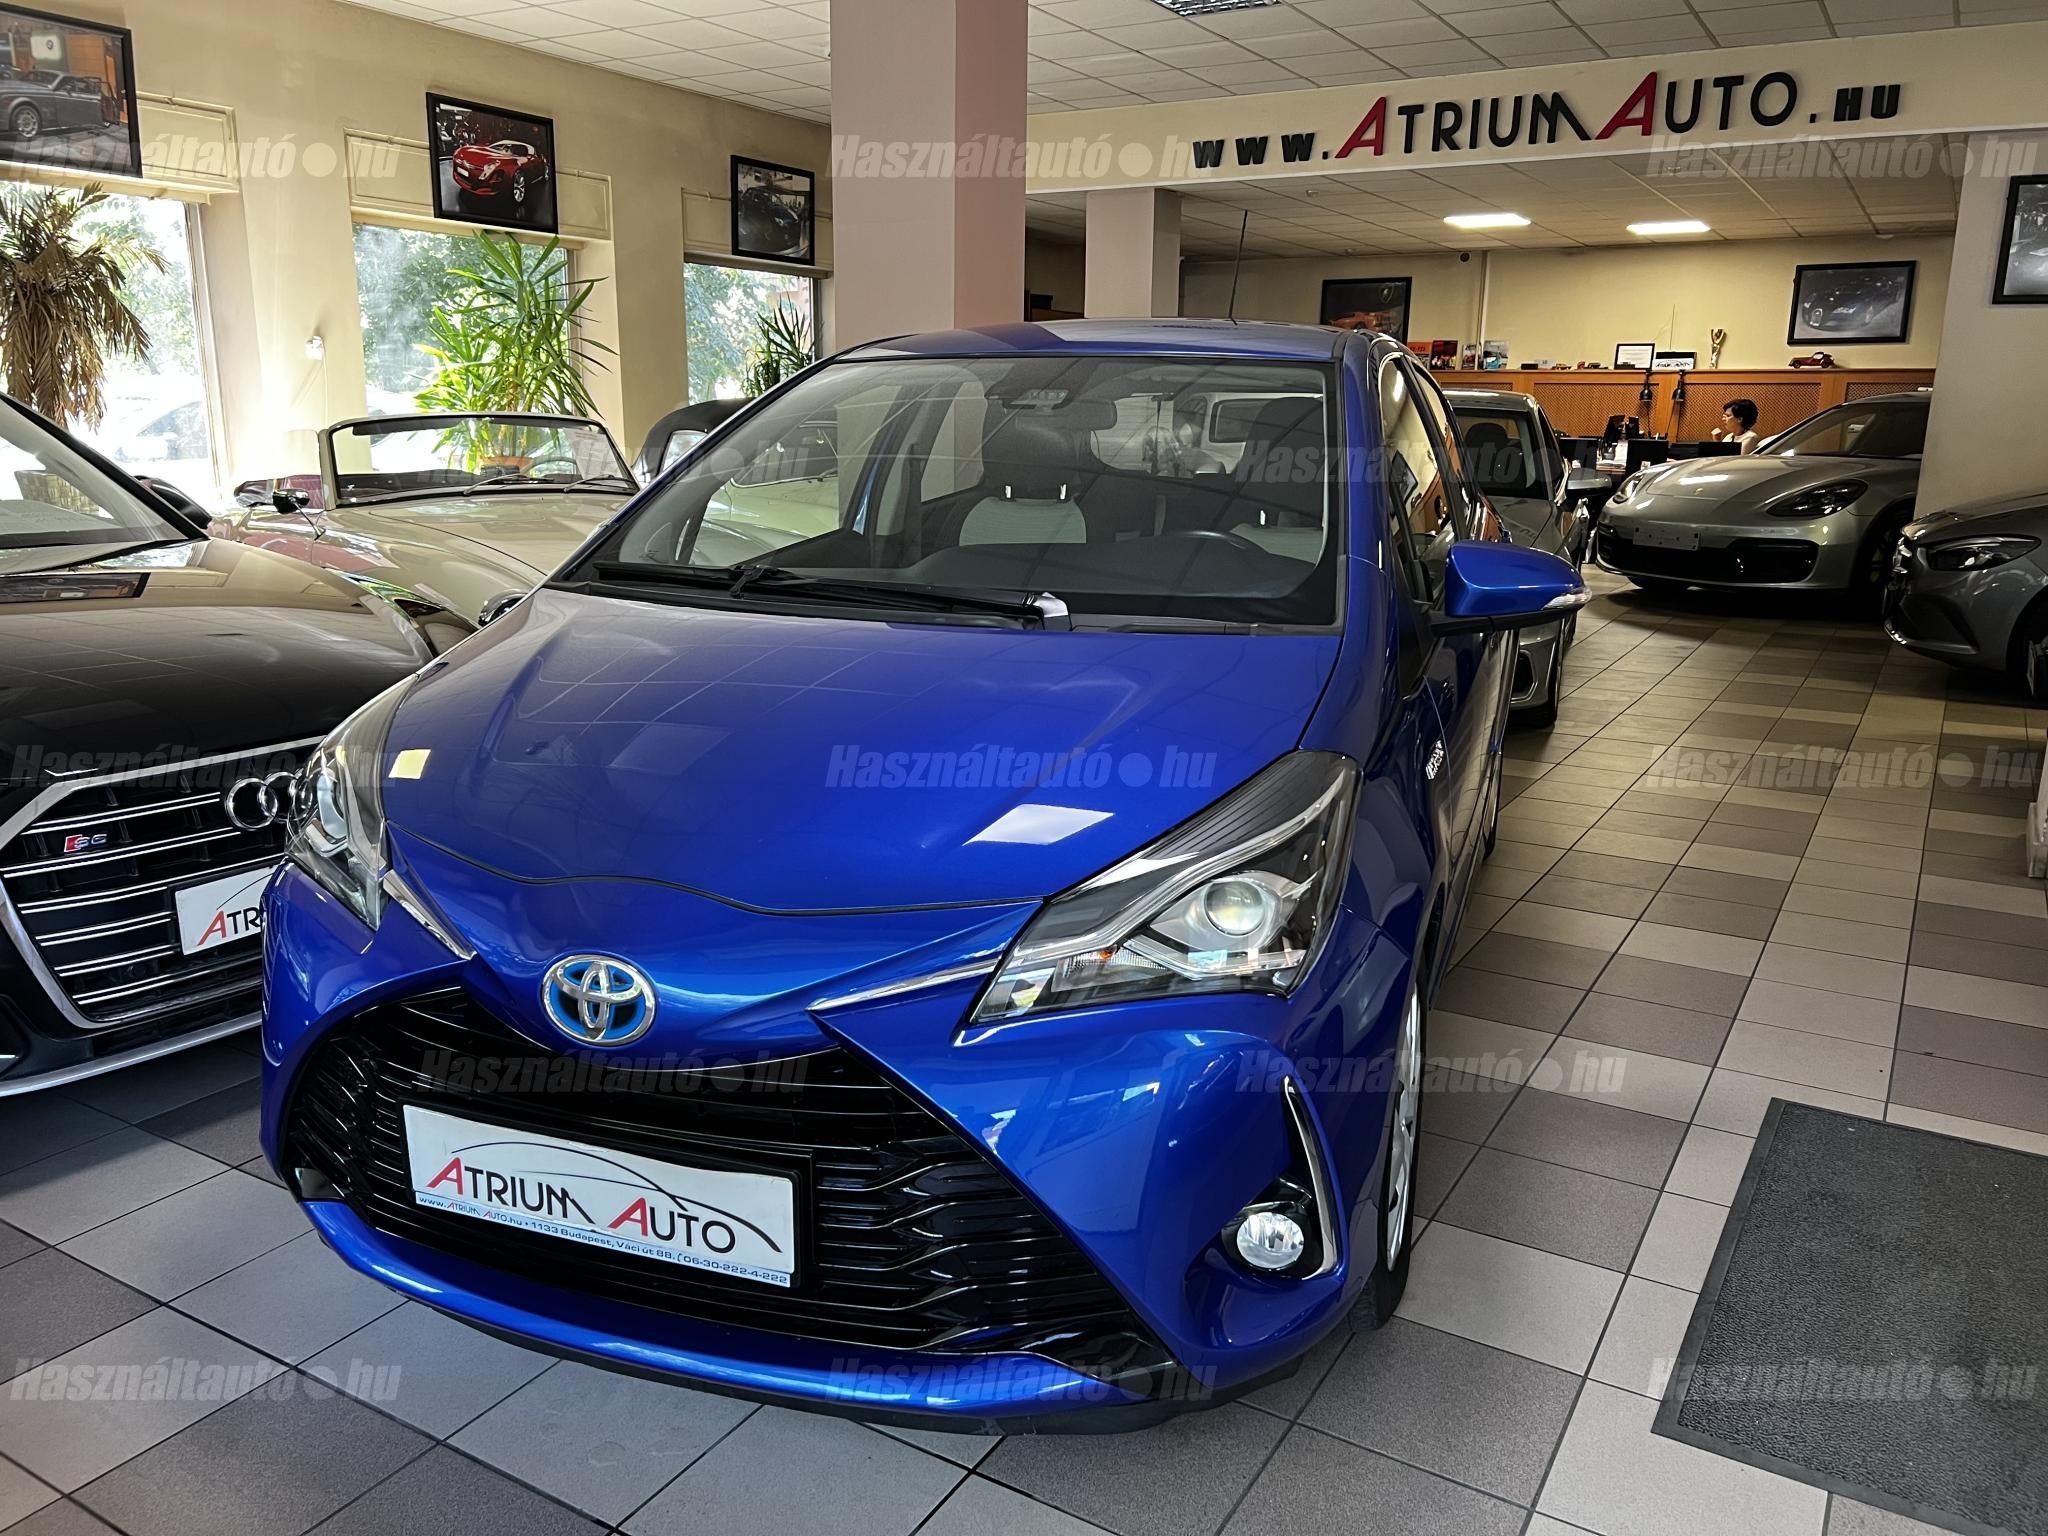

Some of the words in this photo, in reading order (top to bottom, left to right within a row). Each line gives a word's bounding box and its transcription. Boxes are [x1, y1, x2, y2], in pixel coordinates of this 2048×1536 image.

[426, 1157, 596, 1225] ATRIUM
[607, 1197, 736, 1253] AUTO
[531, 1220, 559, 1234] 1133
[615, 1240, 640, 1253] Váci
